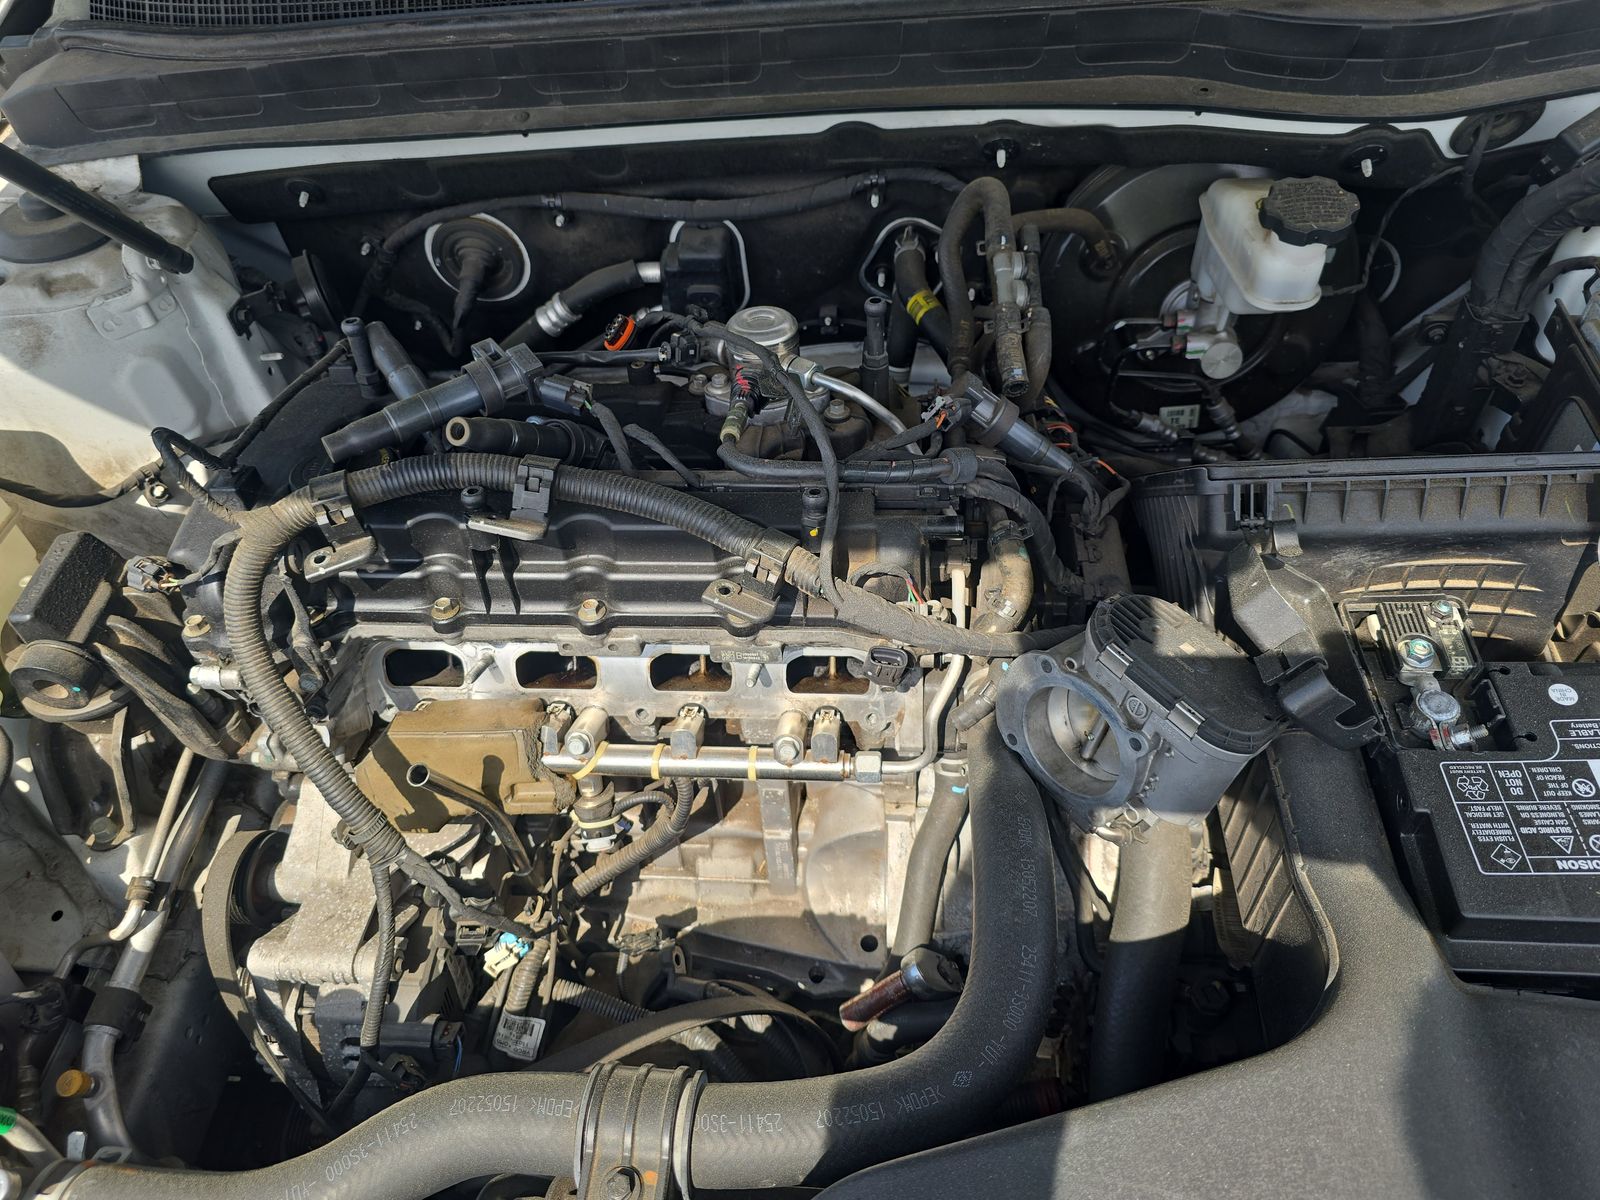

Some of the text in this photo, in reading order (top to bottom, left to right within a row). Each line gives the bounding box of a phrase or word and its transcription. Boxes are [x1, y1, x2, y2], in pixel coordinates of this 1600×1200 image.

[1495, 770, 1522, 778] OPEN.
[1510, 787, 1524, 795] DO
[449, 1094, 518, 1116] 15052207
[324, 1112, 418, 1182] 25411-3S000
